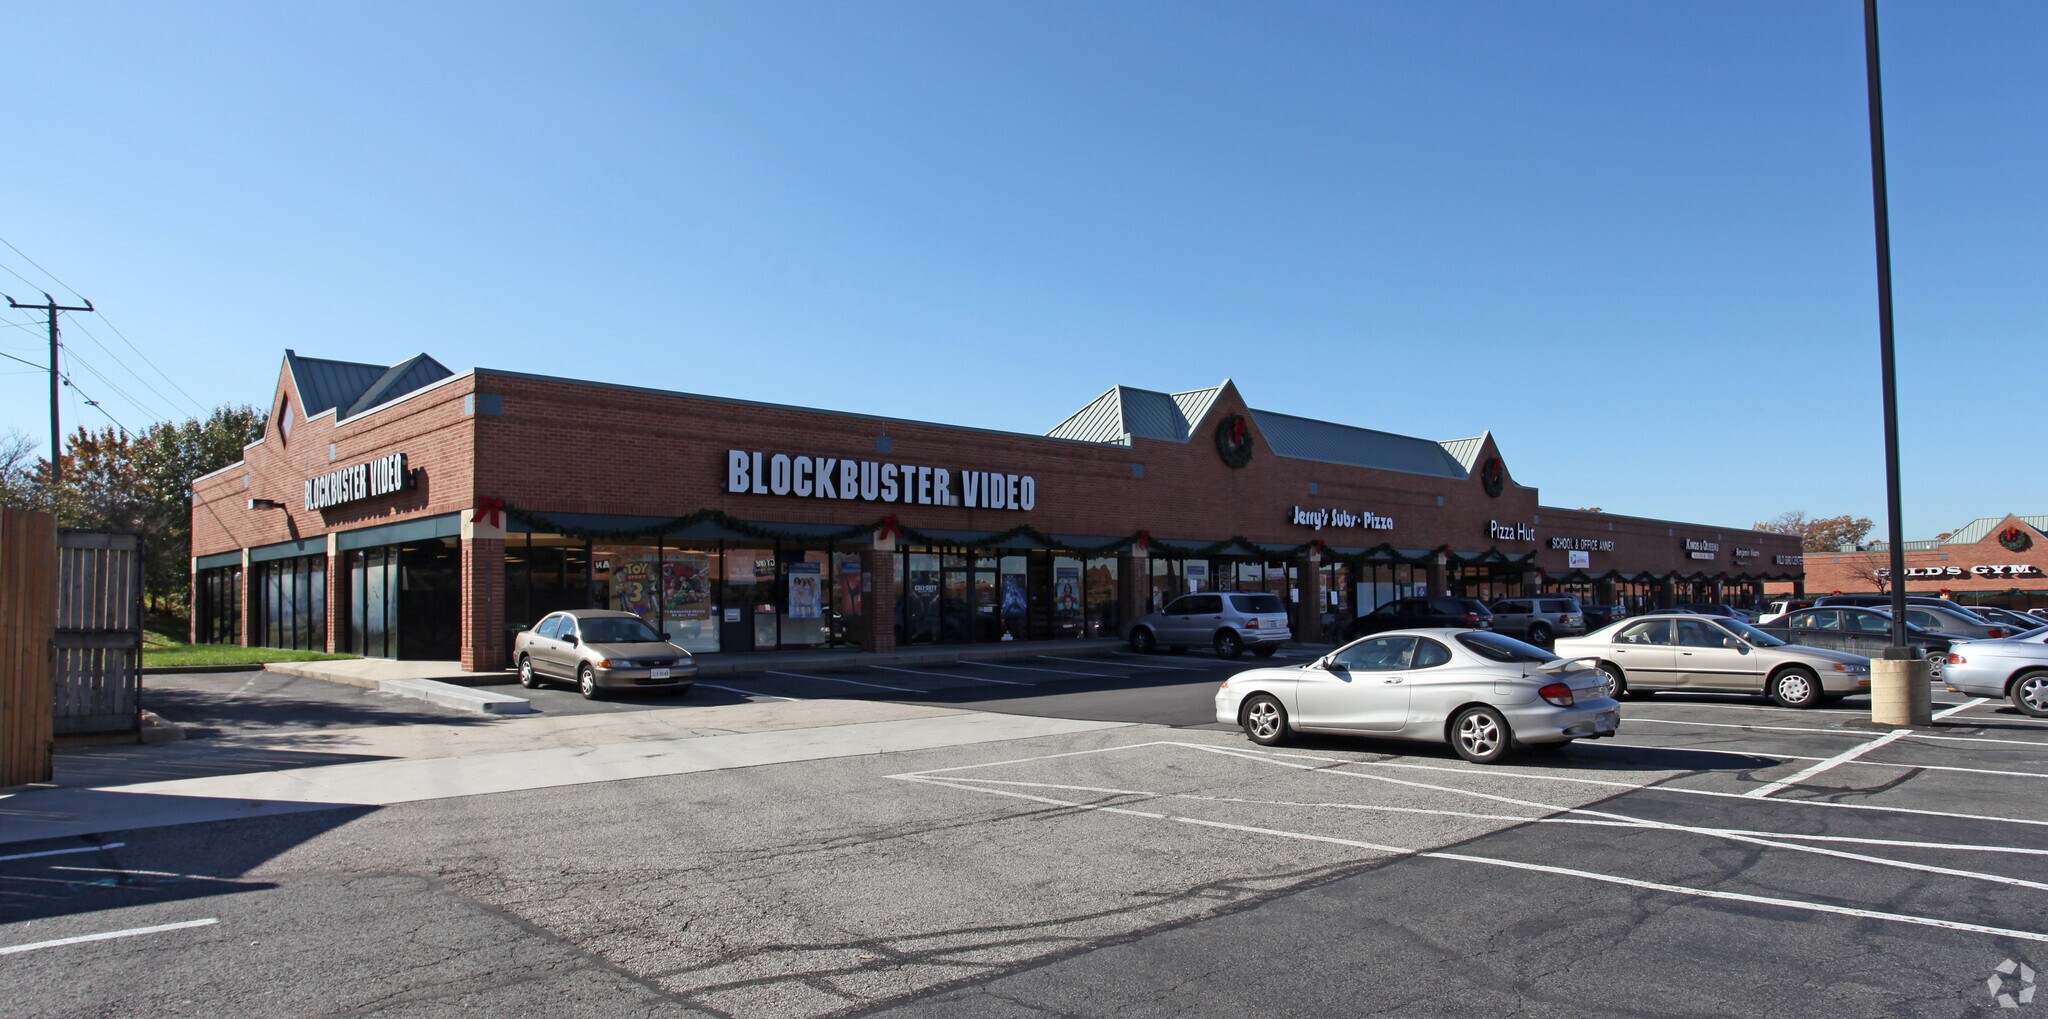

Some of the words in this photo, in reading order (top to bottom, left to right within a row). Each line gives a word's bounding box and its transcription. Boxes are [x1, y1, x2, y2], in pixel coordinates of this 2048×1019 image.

[304, 463, 367, 511] BLOCKBUSTER
[369, 453, 403, 497] VIDEO
[728, 449, 950, 506] BLOCKBUSTER
[962, 470, 1035, 511] VIDEO
[1293, 505, 1329, 530] Jerry's
[1331, 508, 1356, 528] Subs
[1363, 511, 1393, 530] Pizza
[1490, 519, 1515, 540] Pizza
[1516, 522, 1535, 542] Hut
[1552, 537, 1574, 549] SCHOOL
[1575, 538, 1579, 549] &
[1580, 539, 1598, 551] OFFICE
[1599, 541, 1615, 552] ANNEX
[624, 562, 648, 574] TOY
[1873, 565, 1962, 577] GLD'S
[629, 581, 643, 602] 3
